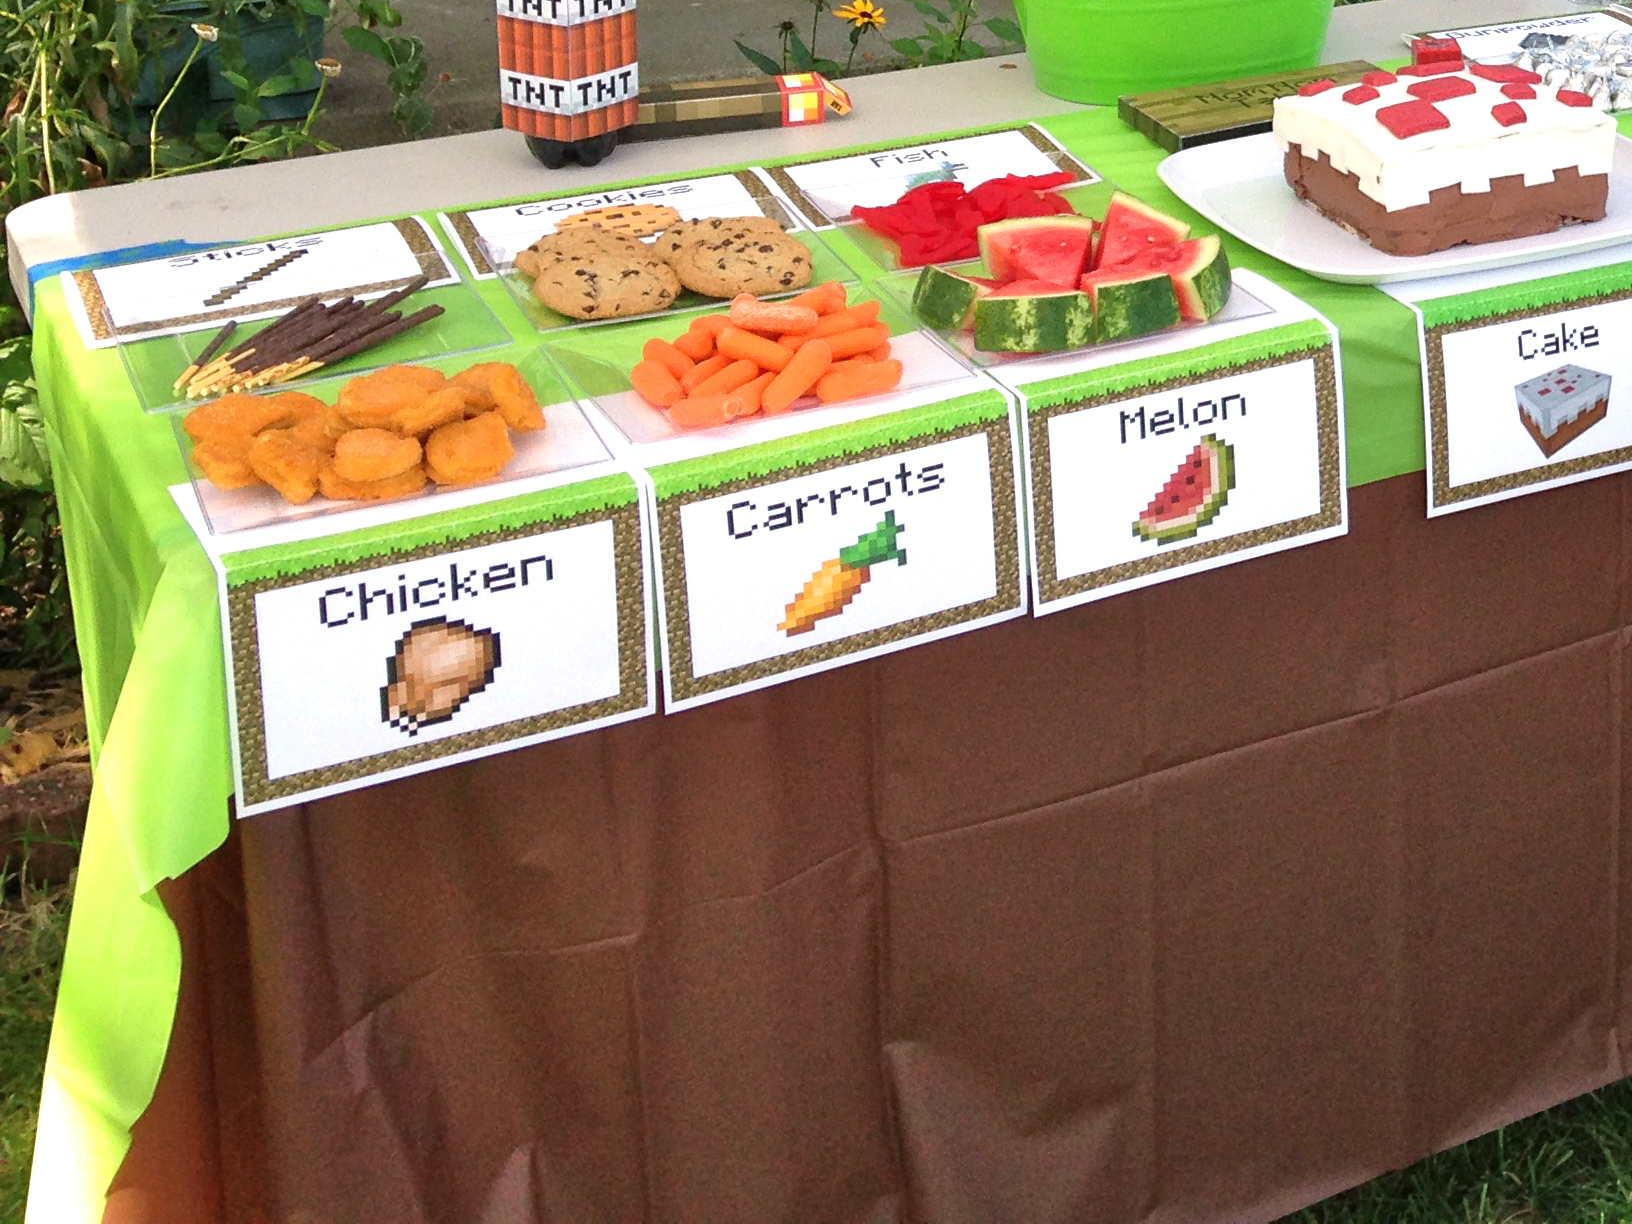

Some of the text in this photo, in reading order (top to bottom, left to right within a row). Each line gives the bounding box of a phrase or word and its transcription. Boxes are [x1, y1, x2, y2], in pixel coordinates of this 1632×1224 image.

[1444, 16, 1595, 40] Gunpowder
[508, 70, 632, 108] TNT TNT
[868, 148, 949, 169] Fish
[514, 184, 694, 218] Cookies
[167, 237, 324, 268] Sticks
[1517, 322, 1600, 361] Cake
[1119, 393, 1247, 444] Melon
[726, 461, 945, 541] Carrots
[318, 554, 555, 628] Chicken
